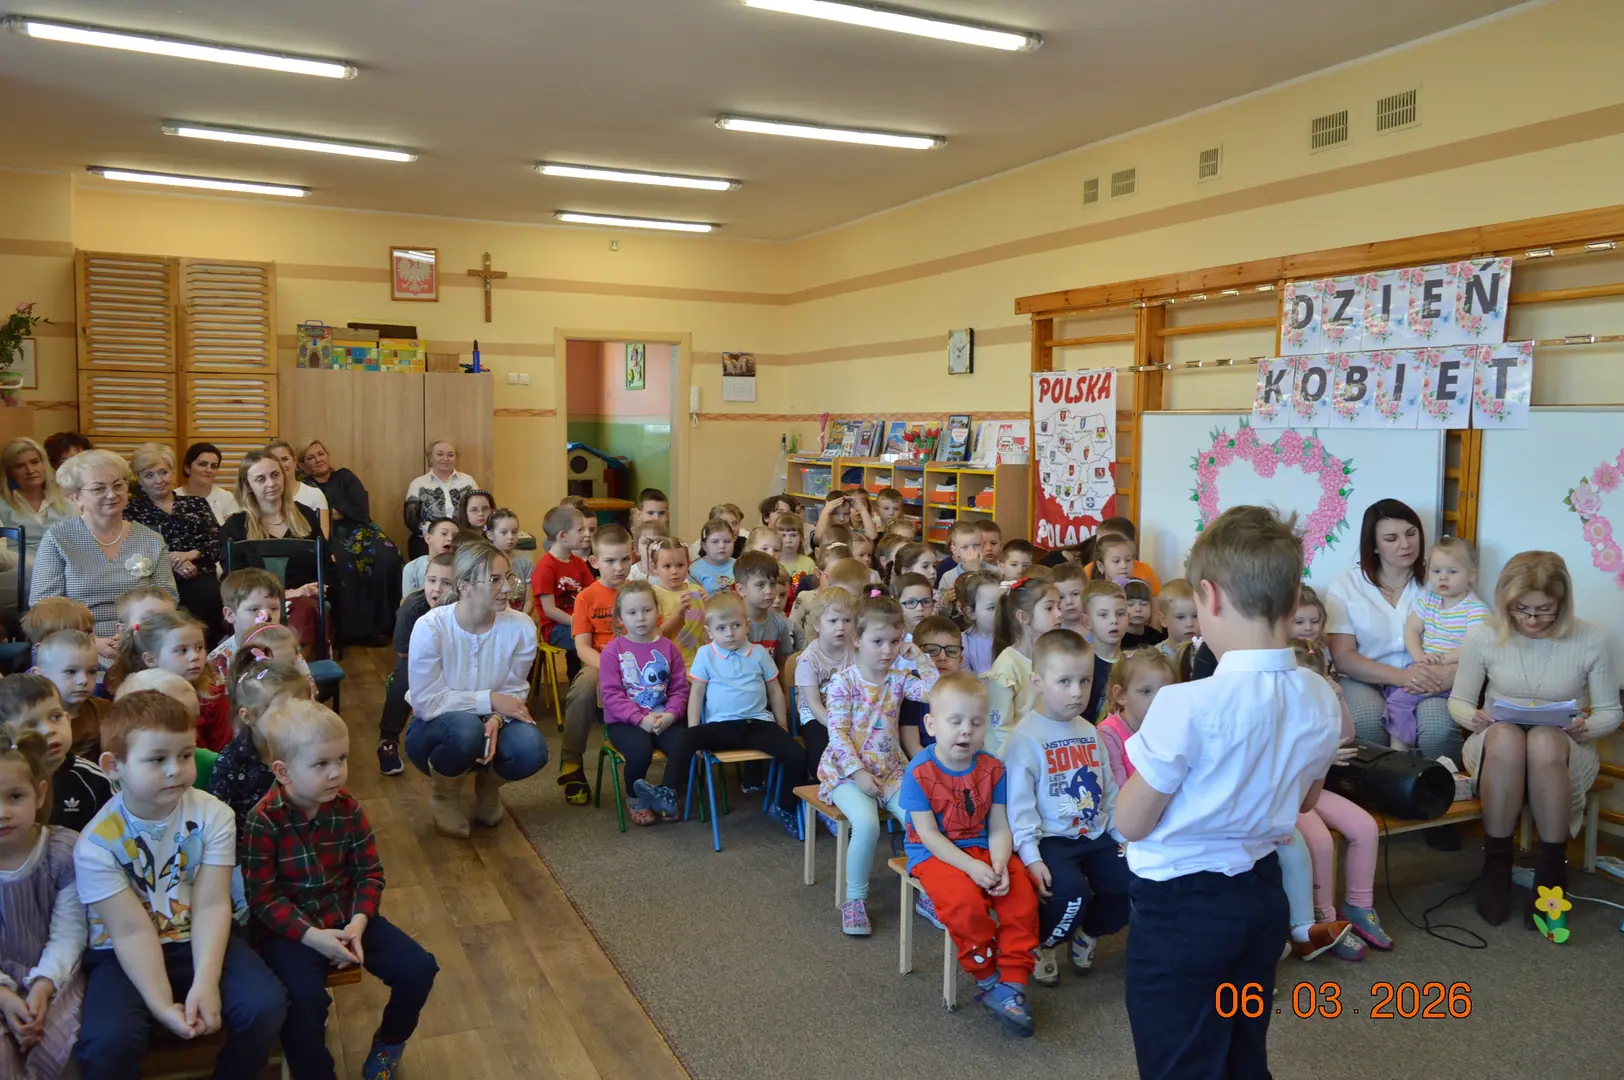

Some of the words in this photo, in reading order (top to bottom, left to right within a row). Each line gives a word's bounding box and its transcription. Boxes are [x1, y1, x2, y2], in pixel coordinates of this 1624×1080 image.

[1291, 261, 1500, 330] DZIEŃ
[1038, 372, 1112, 404] POLSKA
[1264, 357, 1518, 404] KOBIET
[1036, 519, 1098, 547] POLAN
[1045, 744, 1100, 774] SONIC
[1049, 781, 1070, 797] GO
[1052, 897, 1082, 938] PATROL
